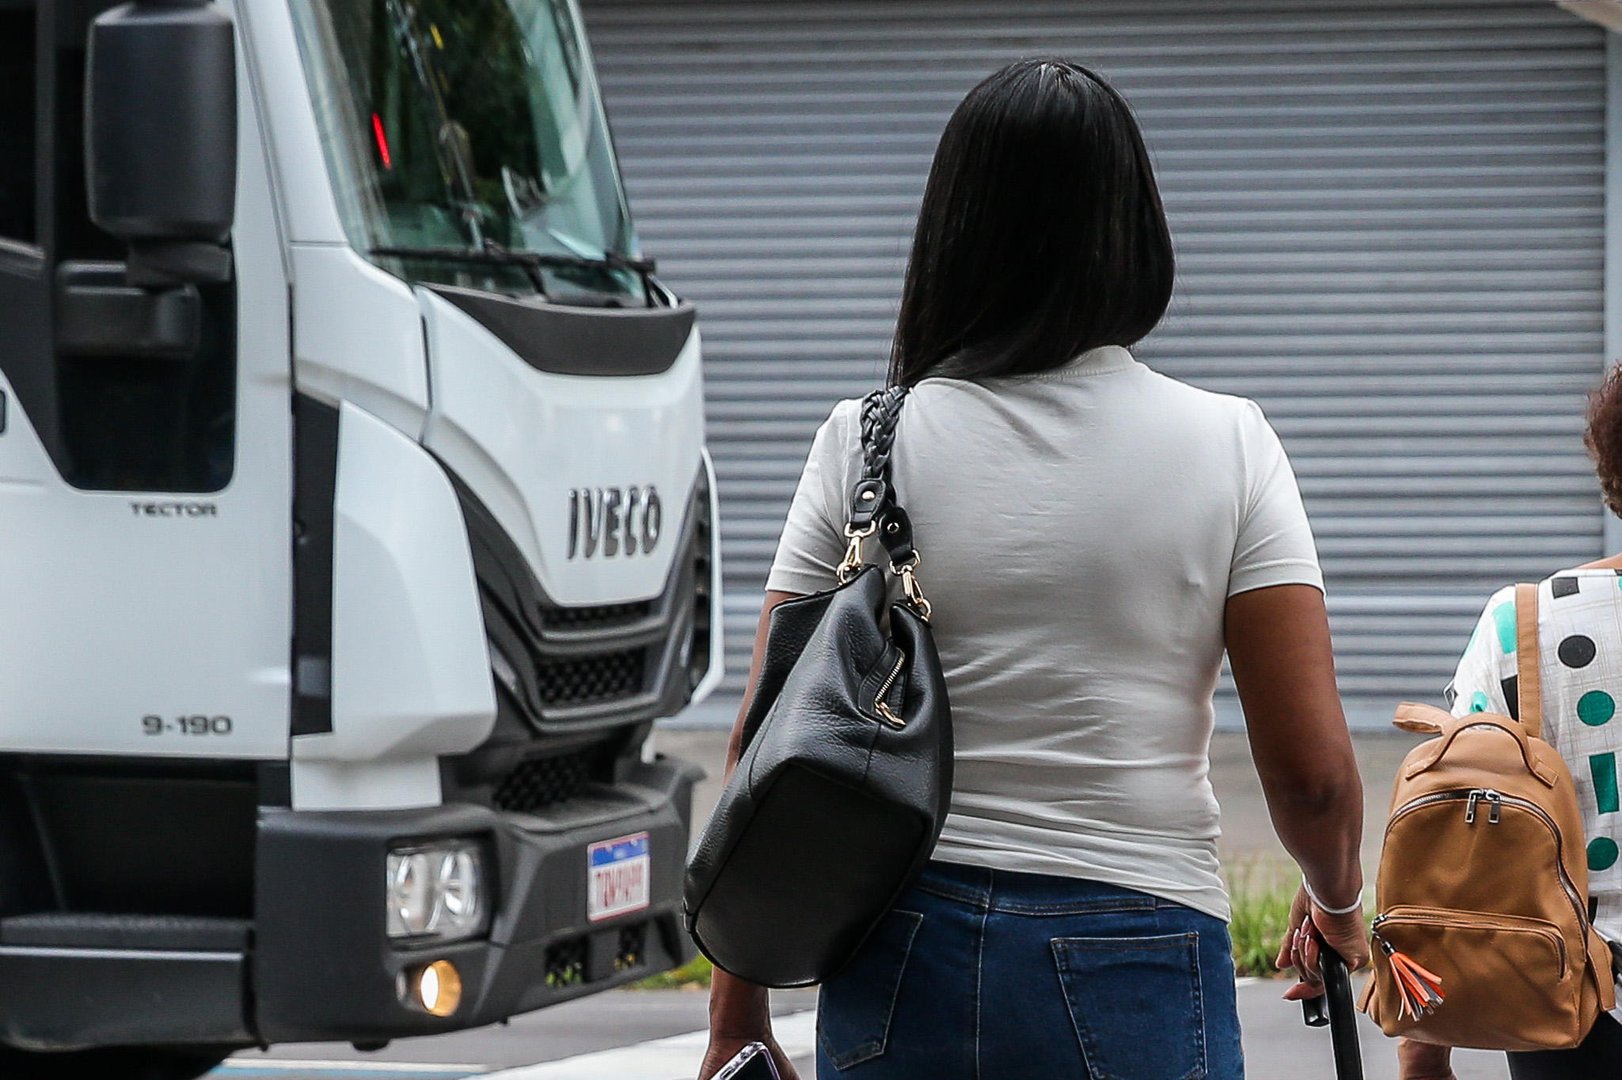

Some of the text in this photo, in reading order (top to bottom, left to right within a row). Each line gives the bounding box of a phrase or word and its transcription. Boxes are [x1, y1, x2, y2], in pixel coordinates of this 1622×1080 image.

[130, 501, 218, 518] TECTOR
[566, 484, 662, 562] IVECO
[142, 714, 232, 736] 9-190
